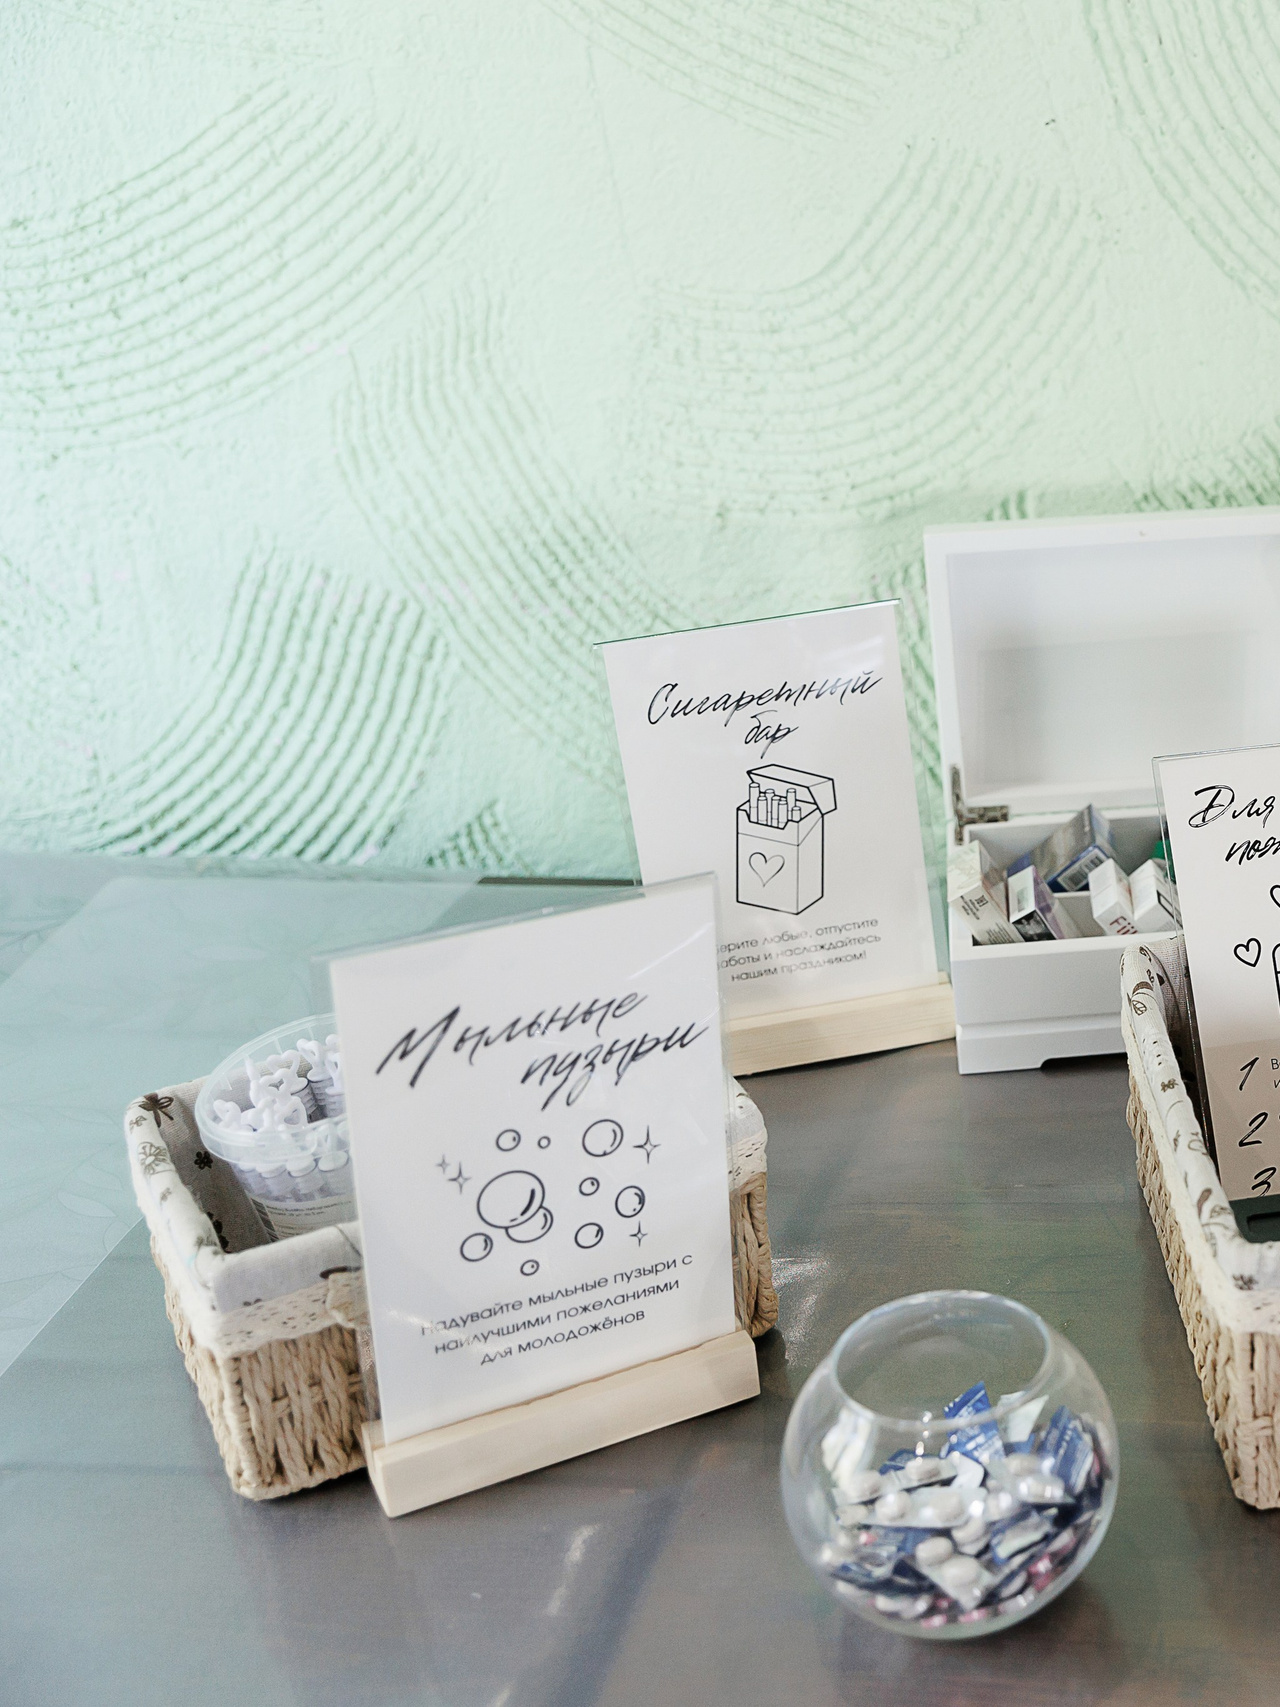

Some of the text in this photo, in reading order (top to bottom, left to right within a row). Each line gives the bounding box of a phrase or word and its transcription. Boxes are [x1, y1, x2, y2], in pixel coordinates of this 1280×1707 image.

[647, 670, 883, 727] Сигаретный
[744, 709, 799, 759] бар
[1188, 784, 1276, 828] Для
[717, 939, 759, 954] ерите
[815, 918, 879, 936] отпустите
[763, 952, 773, 961] и
[776, 934, 882, 959] наслаждайтесь
[731, 949, 867, 982] нашим праздником!
[375, 991, 648, 1088] Мыльные
[520, 1022, 710, 1112] пузыри
[1238, 1057, 1259, 1091] 1
[1238, 1111, 1268, 1147] 2
[1251, 1166, 1277, 1198] 3
[528, 1276, 609, 1308] мыльные
[613, 1258, 678, 1286] пузыри
[681, 1254, 693, 1266] с
[434, 1278, 680, 1354] наилучшими пожеланиями
[480, 1309, 646, 1366] для молодожёнов
